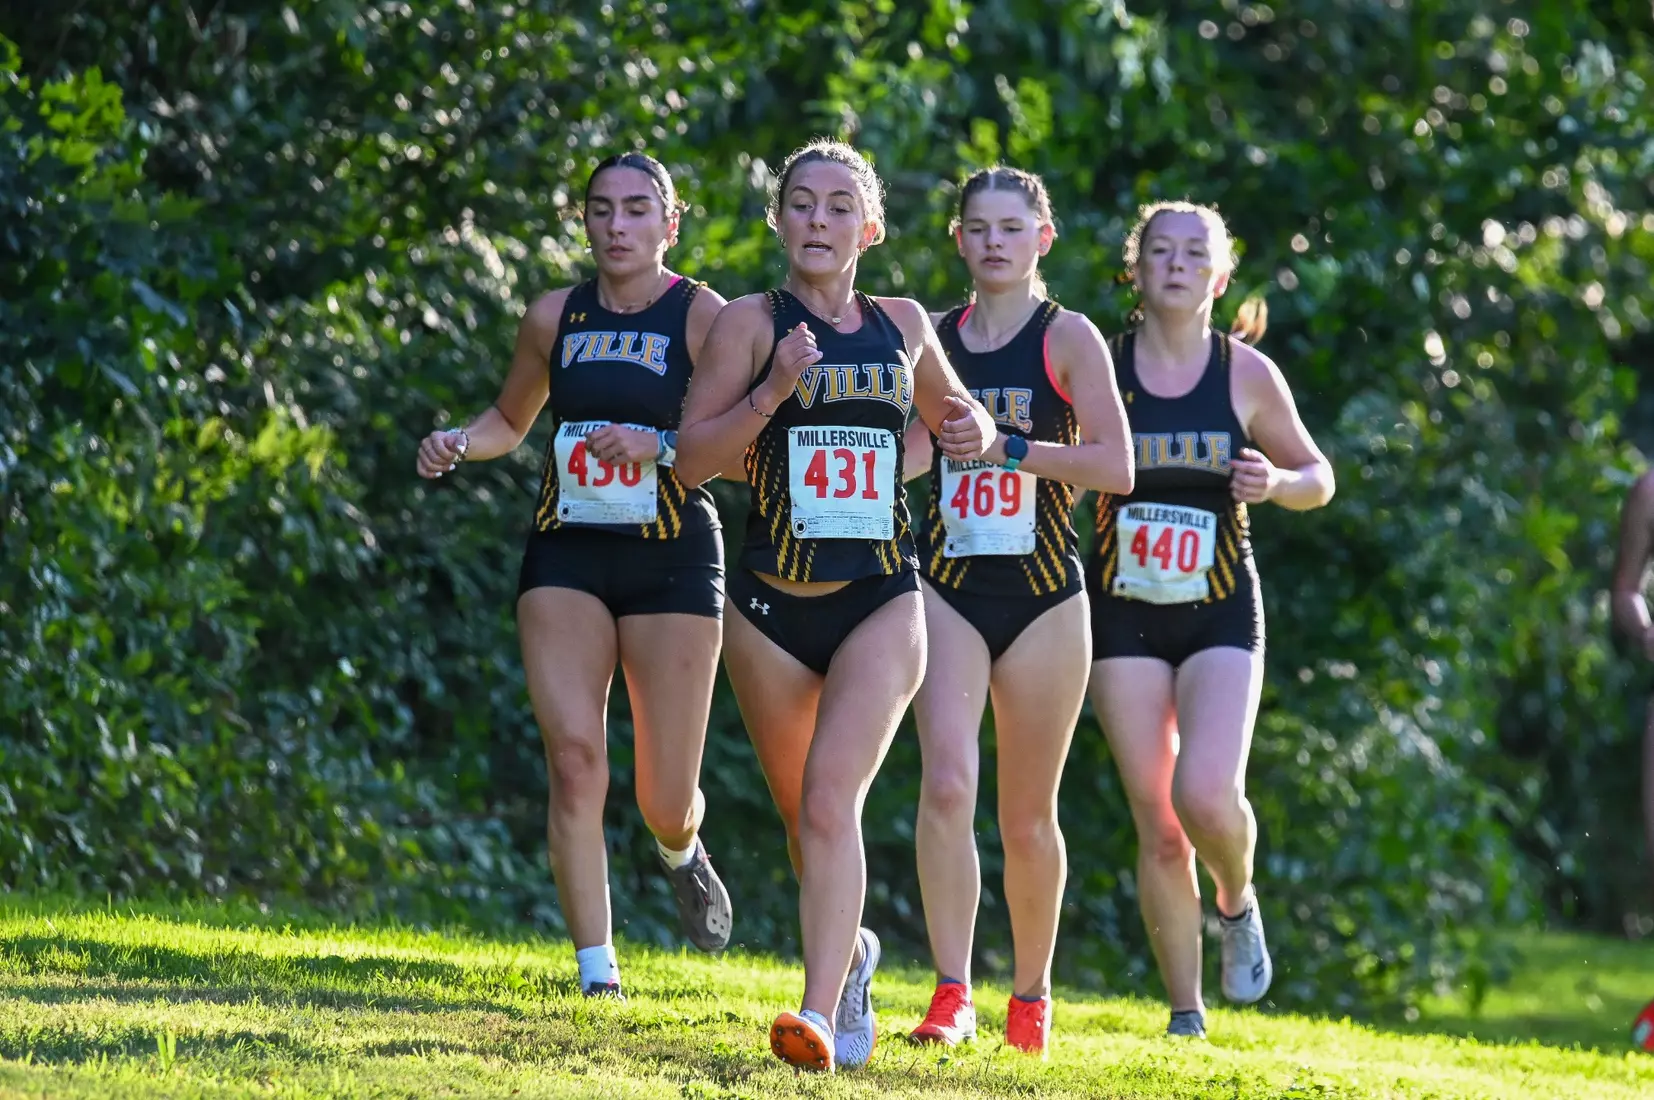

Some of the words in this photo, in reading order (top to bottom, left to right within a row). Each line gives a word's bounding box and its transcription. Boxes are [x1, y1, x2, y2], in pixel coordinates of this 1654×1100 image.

[561, 331, 669, 376] VILLE
[795, 364, 913, 415] VILLE
[797, 430, 889, 449] MILLERSVILLE
[1132, 431, 1231, 477] ILLE
[804, 448, 879, 500] 431
[950, 471, 1021, 519] 469
[1126, 507, 1210, 529] MILLERSVILLE
[1130, 524, 1200, 573] 440
